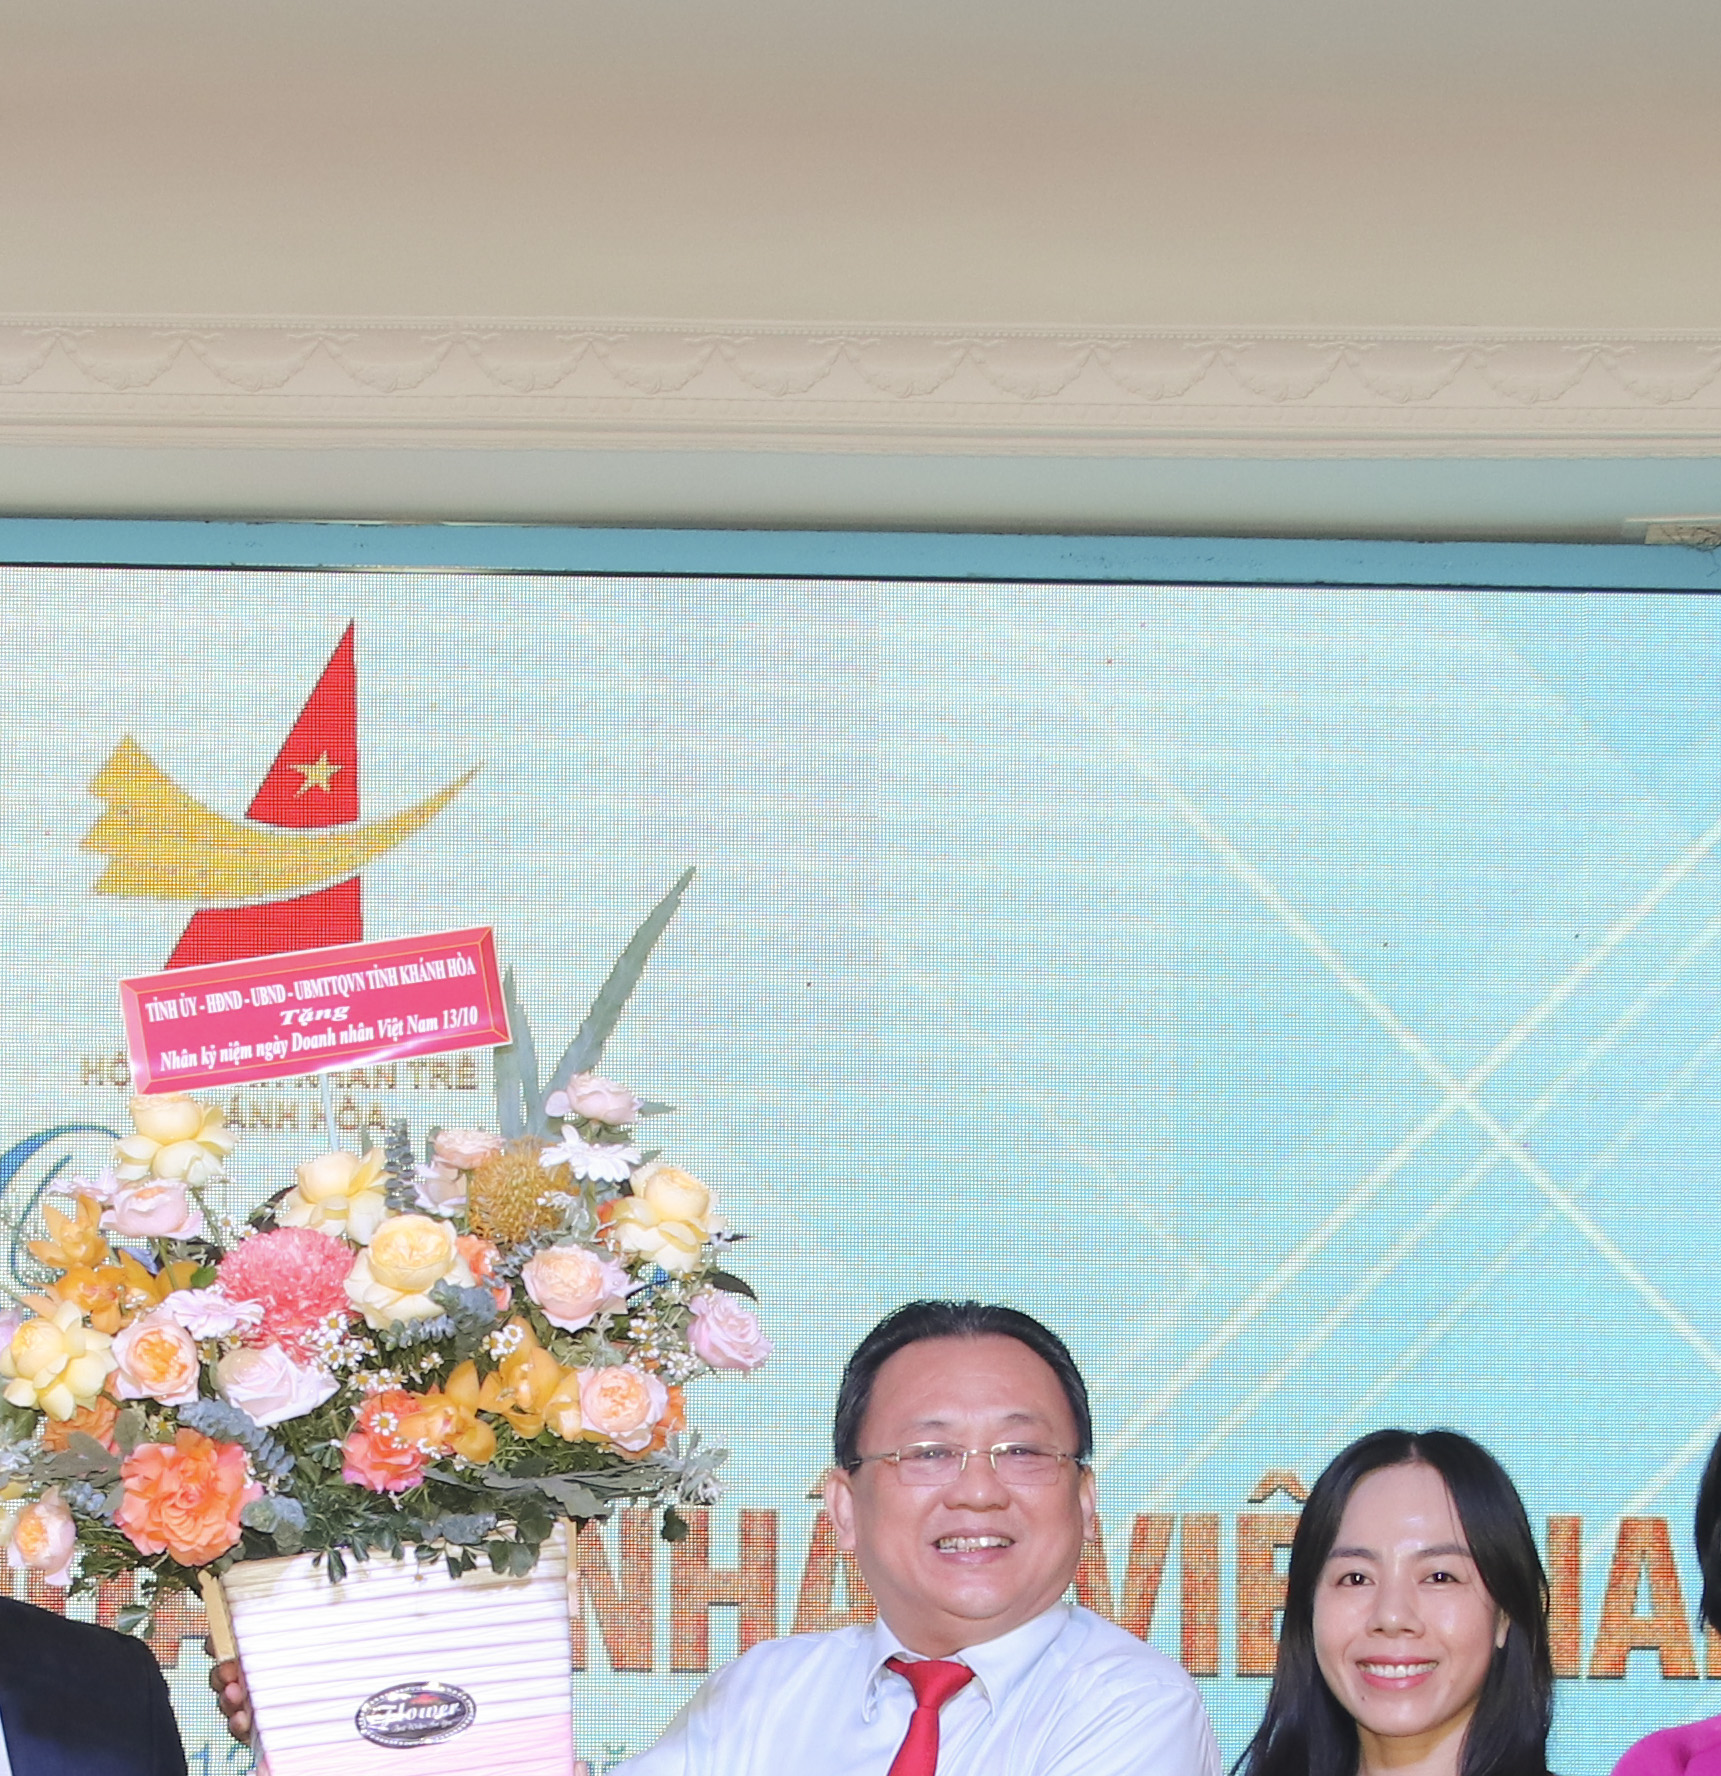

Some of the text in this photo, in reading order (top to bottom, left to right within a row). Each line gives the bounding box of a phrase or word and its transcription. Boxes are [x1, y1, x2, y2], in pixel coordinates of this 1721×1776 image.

[145, 997, 179, 1022] TỈNH
[179, 993, 198, 1018] ỦY
[205, 990, 243, 1014] HĐND
[250, 984, 286, 1007] UBND
[293, 972, 366, 1001] UBMTTQVN
[366, 964, 399, 990] TỈNH
[399, 957, 447, 985] KHÁNH
[447, 951, 477, 978] HÒA
[279, 1006, 350, 1027] Tặng
[160, 1048, 198, 1072] Nhân
[220, 1041, 253, 1066] niệm
[256, 1035, 289, 1061] ngày
[291, 1027, 337, 1052] Doanh
[339, 1022, 374, 1045] nhân
[377, 1017, 404, 1042] Việt
[406, 1014, 439, 1035] Nam
[442, 1006, 479, 1030] 13/10
